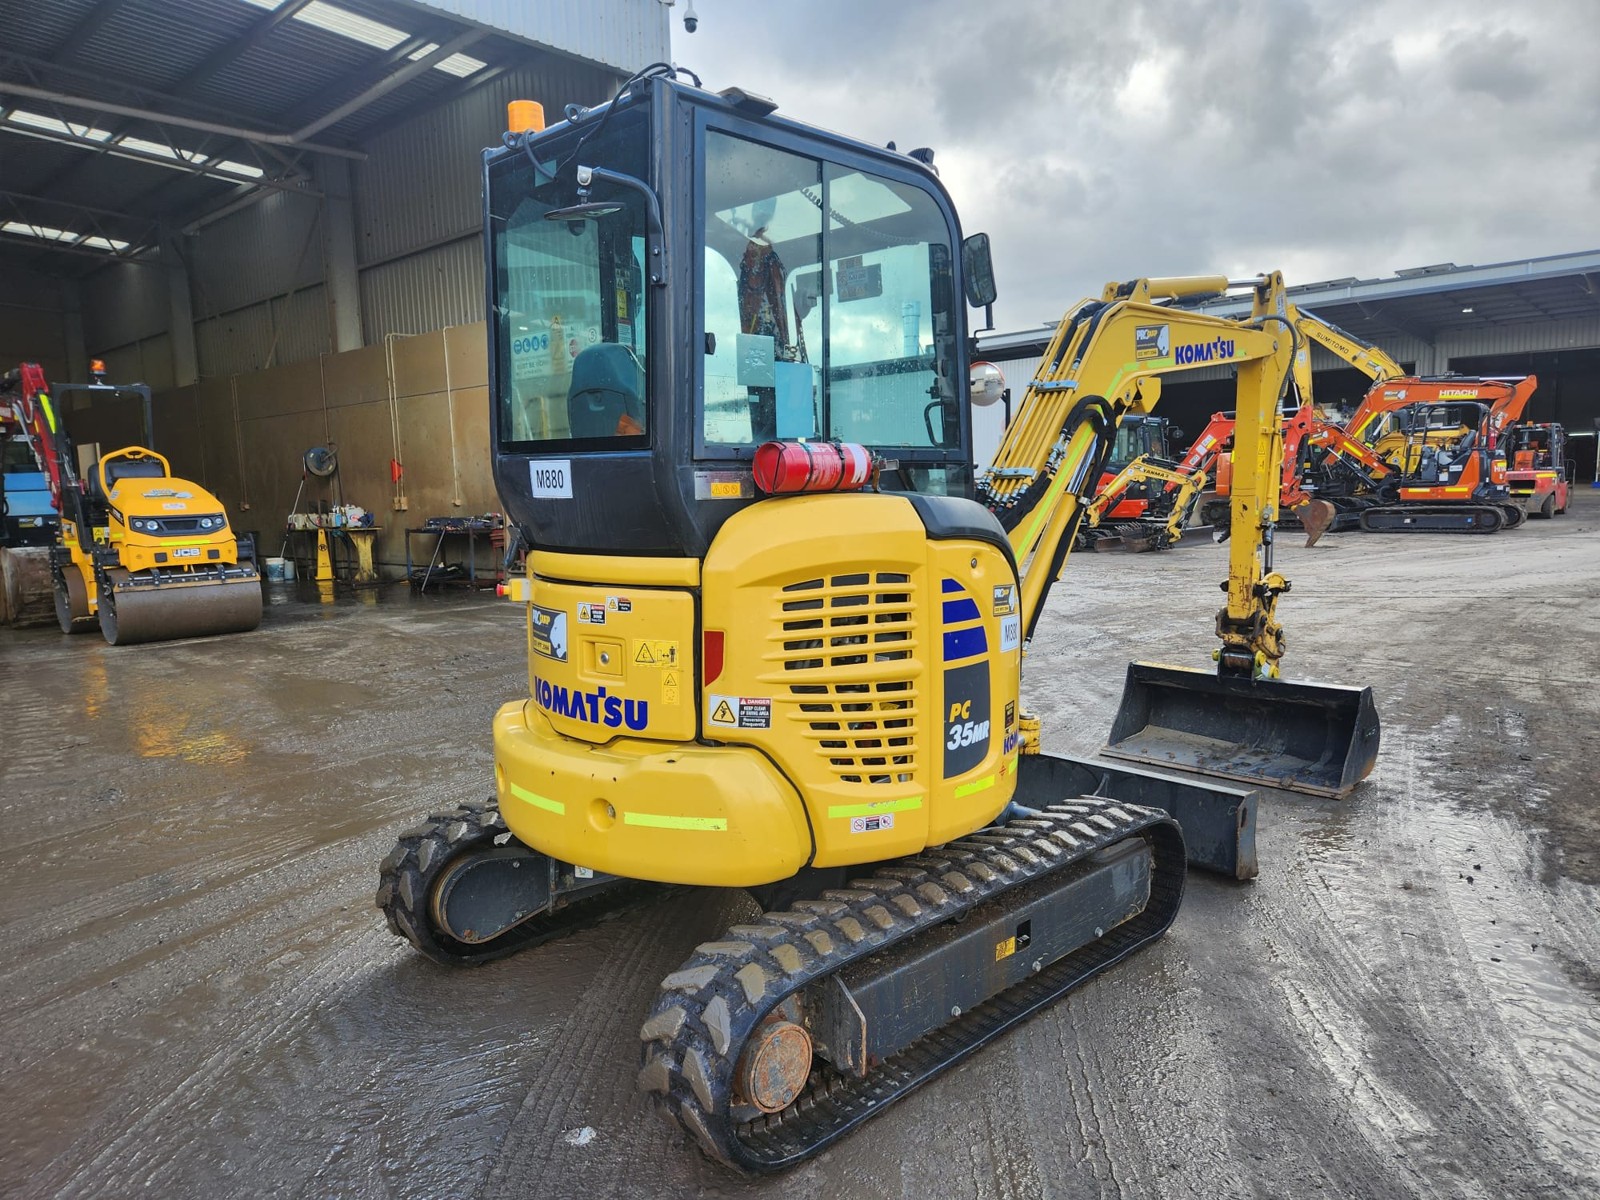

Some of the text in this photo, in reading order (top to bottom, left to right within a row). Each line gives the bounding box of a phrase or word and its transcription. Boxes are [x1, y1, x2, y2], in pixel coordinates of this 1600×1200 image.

[1175, 335, 1234, 365] KOMATSU
[1316, 331, 1350, 355] SUMITOMO
[536, 469, 564, 489] M880
[173, 548, 200, 557] JCB
[534, 675, 648, 731] KOMATSU
[949, 700, 972, 723] PC
[946, 720, 989, 751] 35MR
